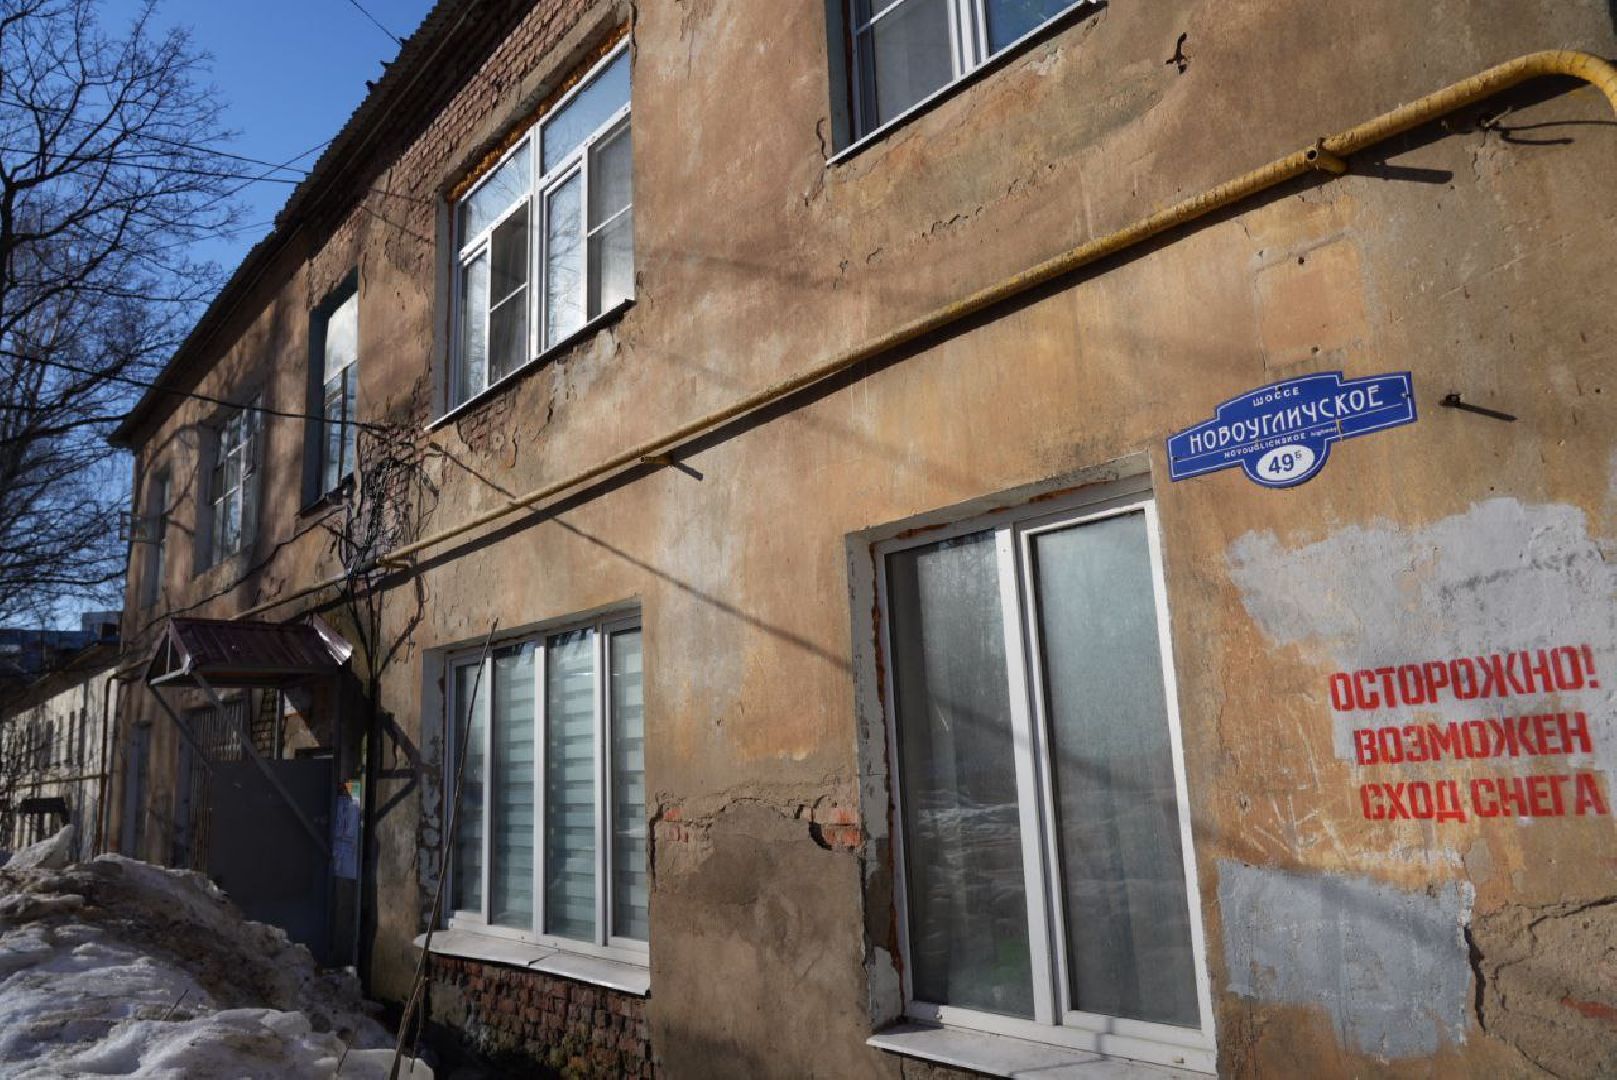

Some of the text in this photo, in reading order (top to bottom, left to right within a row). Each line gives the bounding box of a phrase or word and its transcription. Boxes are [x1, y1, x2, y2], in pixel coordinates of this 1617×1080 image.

[1189, 384, 1384, 454] НОВОУГЛИЧСКОЕ
[1253, 386, 1299, 407] ШОССЕ
[1328, 644, 1600, 712] ОСТОРОЖНО!
[1353, 711, 1593, 766] ВОЗМОЖЕН
[1359, 771, 1611, 824] СХОД СНЕГА
